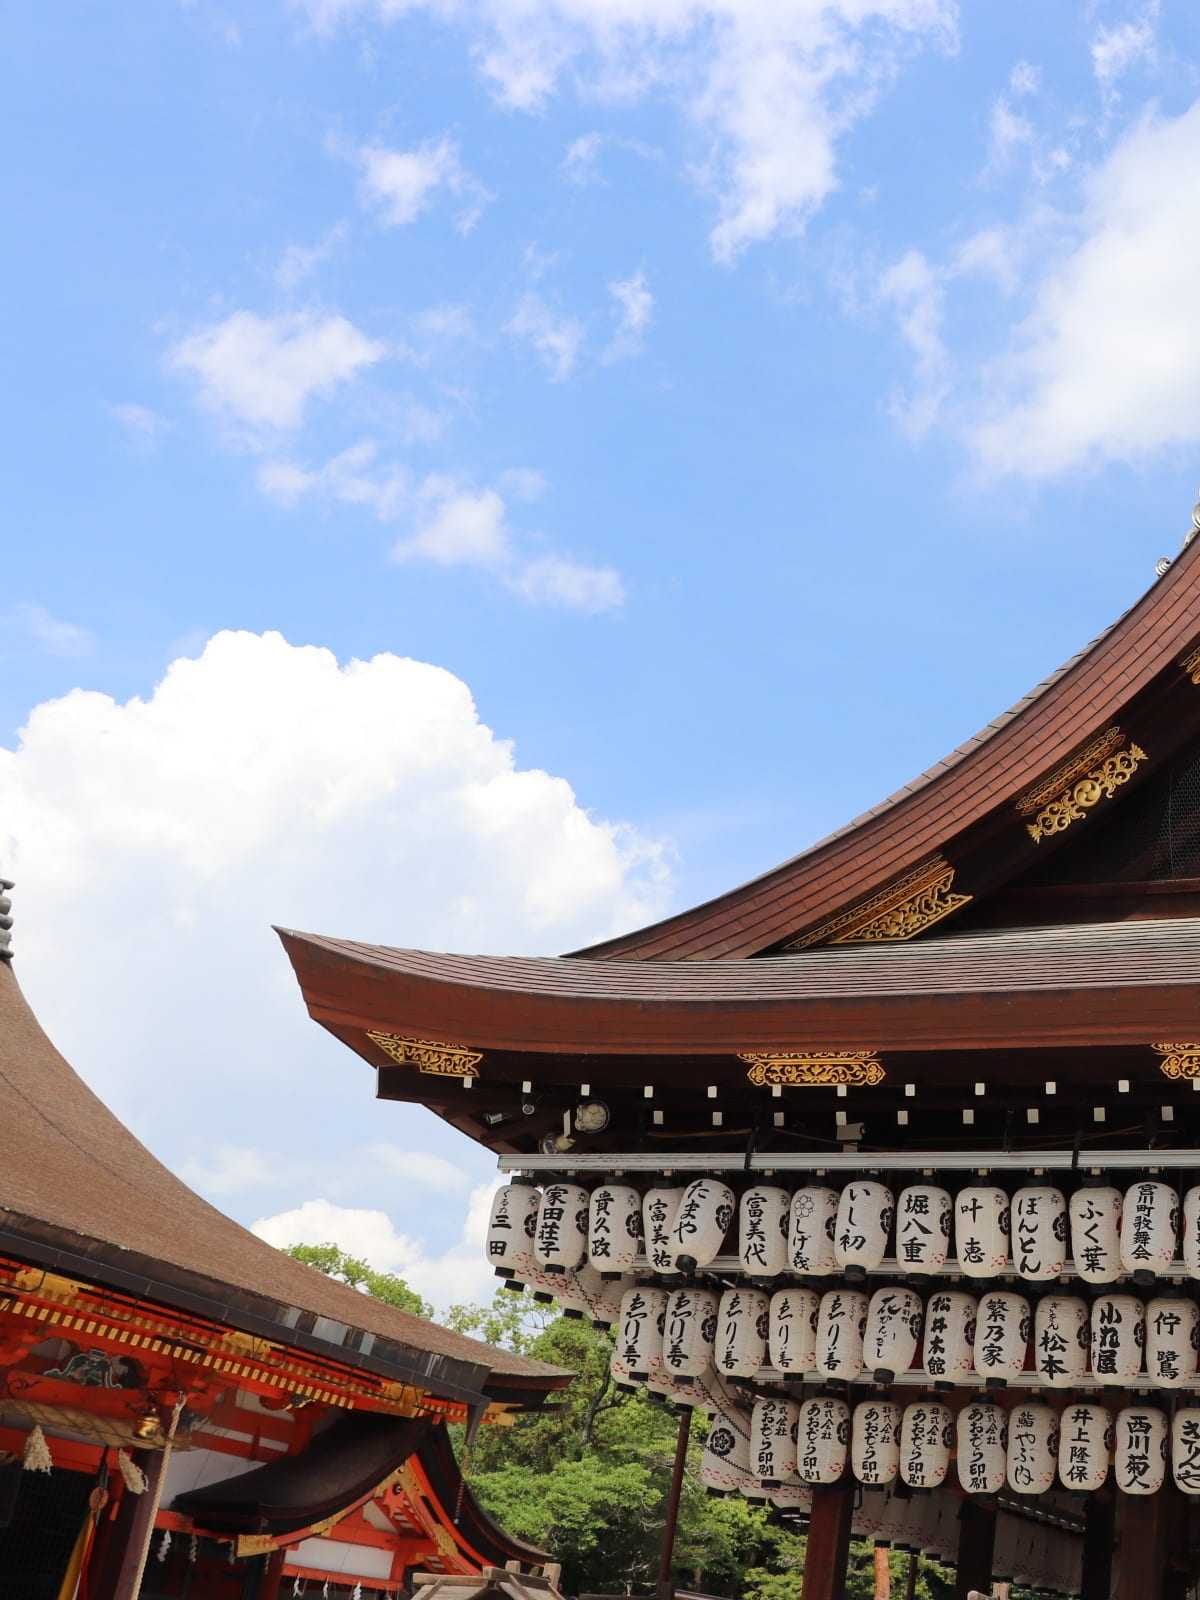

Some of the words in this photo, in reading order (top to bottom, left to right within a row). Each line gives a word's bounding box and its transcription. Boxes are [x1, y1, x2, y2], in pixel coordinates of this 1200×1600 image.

[538, 1186, 568, 1258] 家田荘子
[591, 1191, 615, 1258] 貴久政
[673, 1181, 710, 1244] たまや
[744, 1193, 768, 1267] 富美代
[839, 1188, 872, 1253] いし初
[902, 1194, 933, 1264] 堀八重
[960, 1197, 986, 1264] 叶恵
[1018, 1196, 1042, 1275] ぼんとん
[1079, 1200, 1108, 1273] ふく葉
[1131, 1183, 1159, 1261] 宮川町歌舞会
[927, 1296, 952, 1376] 松井本館
[982, 1298, 1010, 1367] 繁乃家
[757, 1401, 776, 1477] あおぞら印刷
[803, 1403, 821, 1481] あおぞら印刷
[861, 1407, 880, 1483] あおぞら印刷
[907, 1409, 927, 1486] あおぞら印刷
[968, 1408, 988, 1490] あおぞら印刷
[1066, 1408, 1094, 1484] 井上隆保
[1124, 1415, 1153, 1490] 西川菊人
